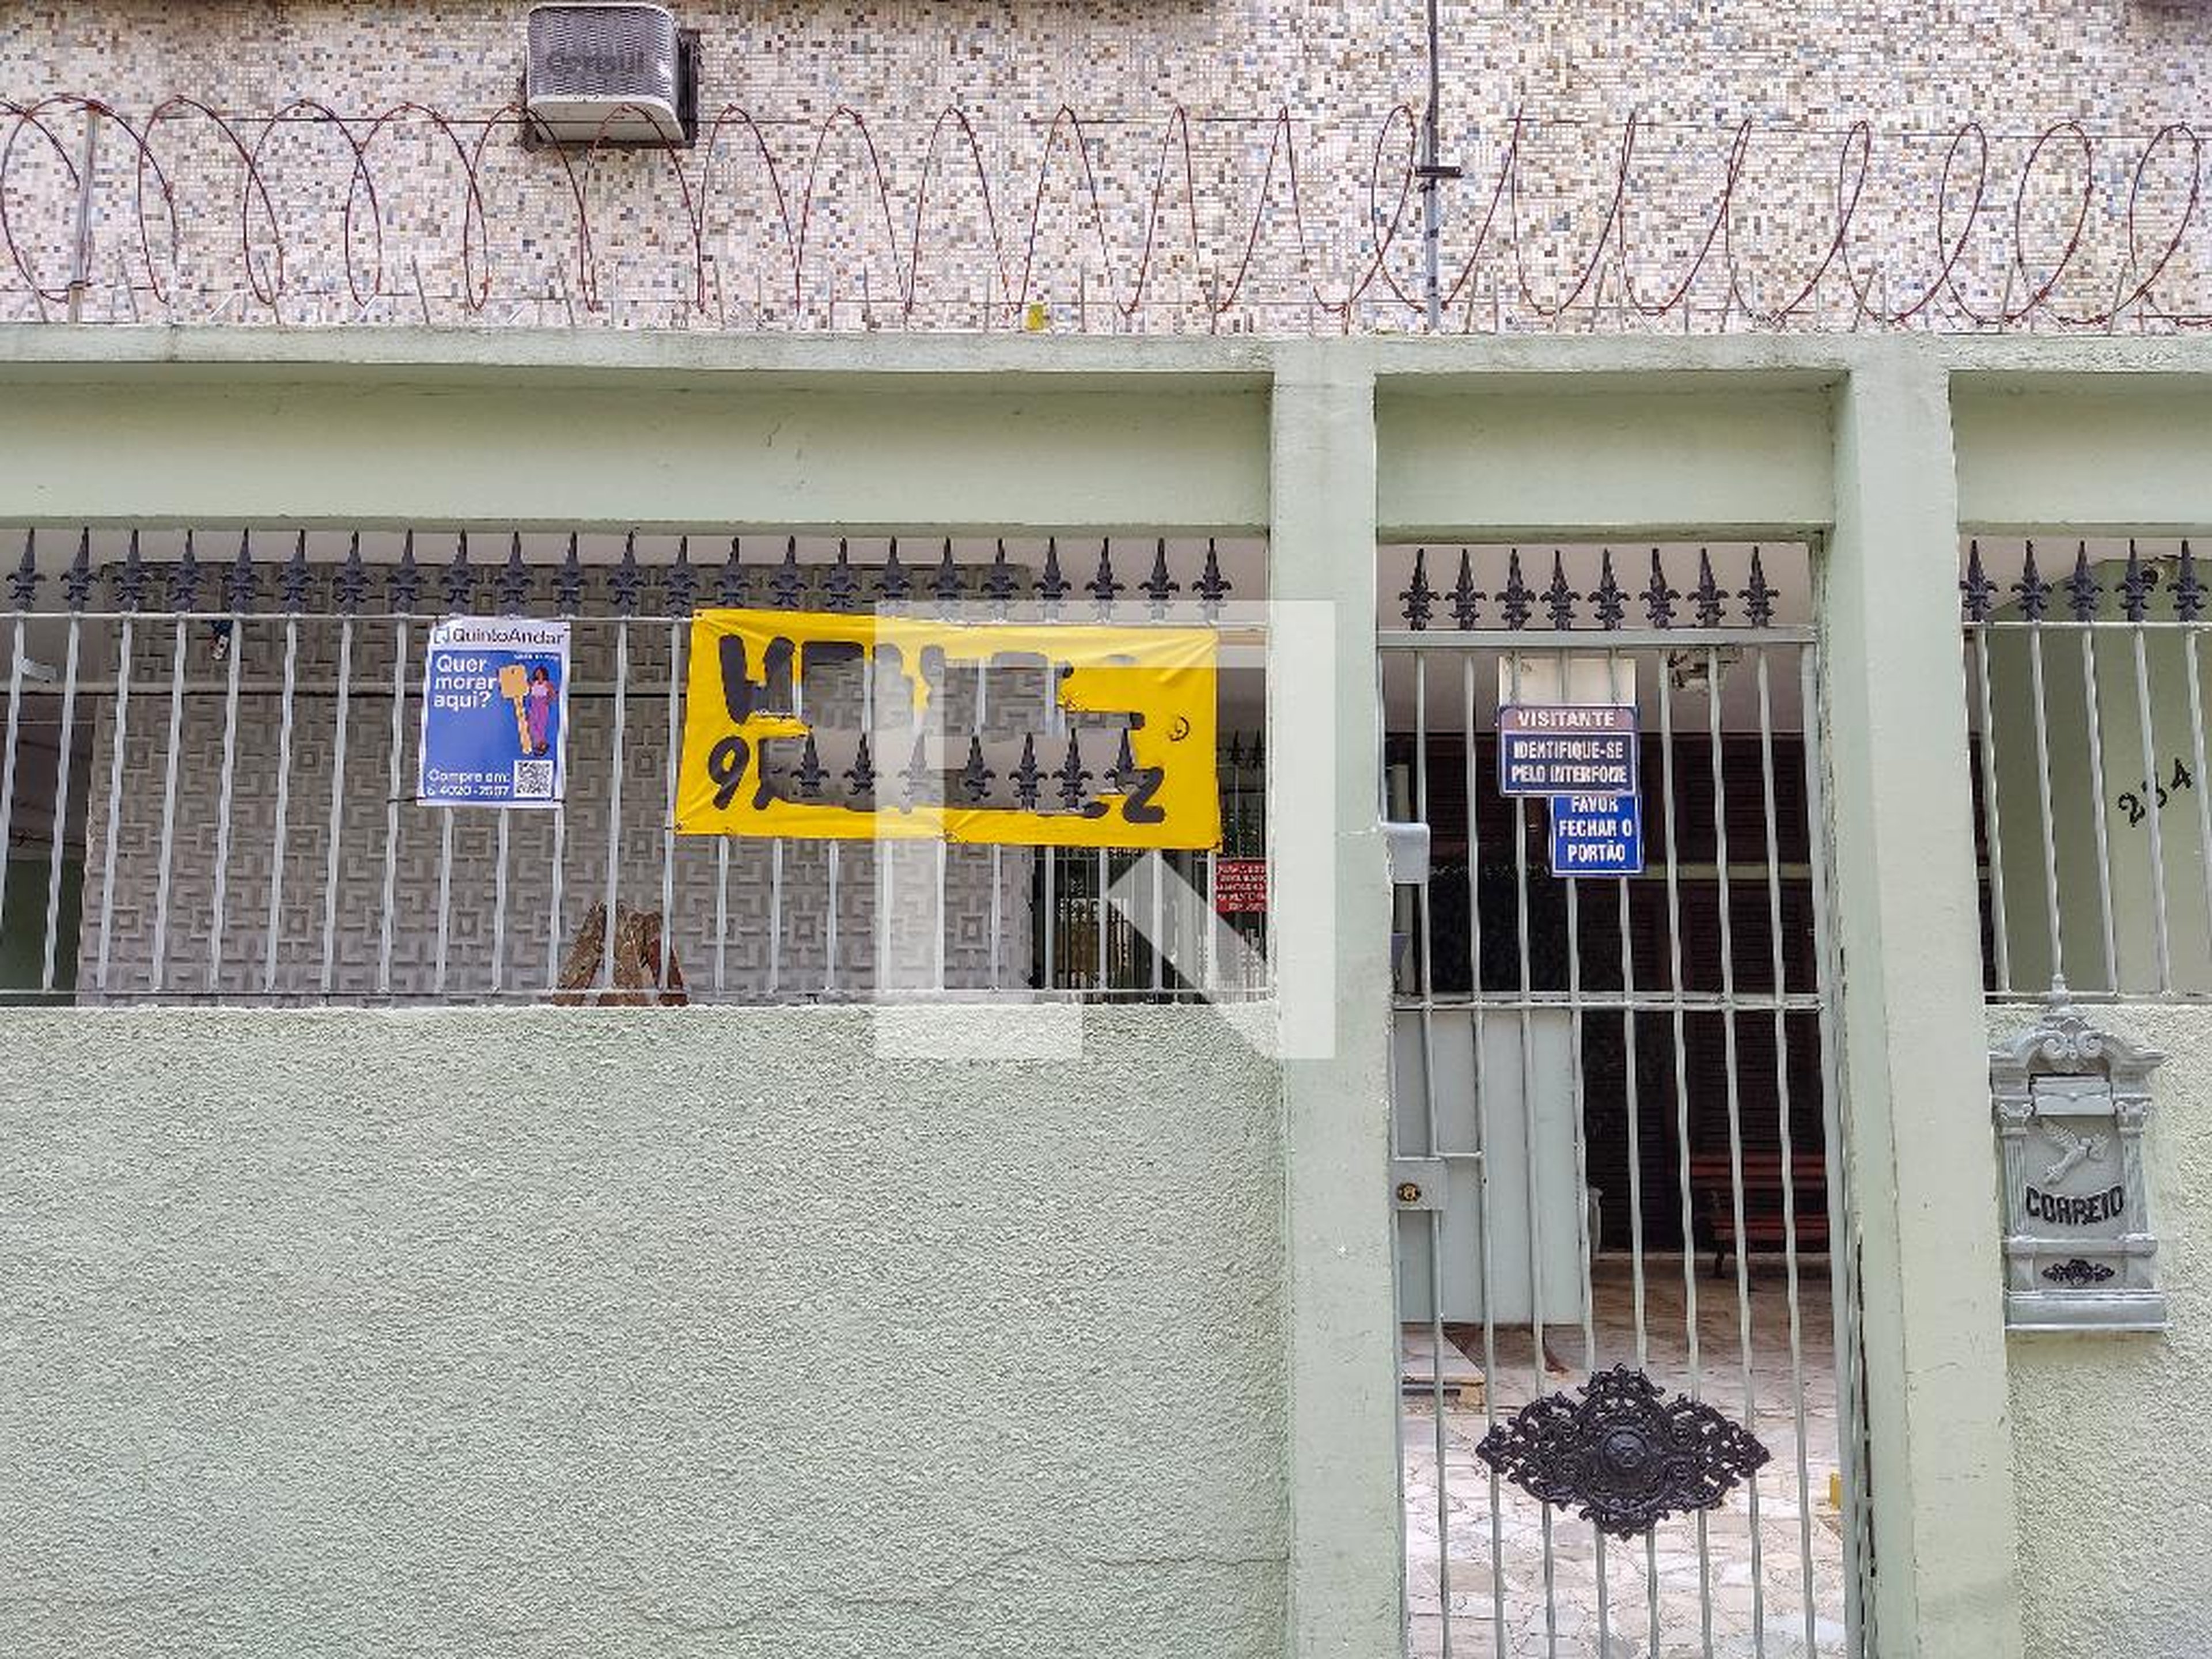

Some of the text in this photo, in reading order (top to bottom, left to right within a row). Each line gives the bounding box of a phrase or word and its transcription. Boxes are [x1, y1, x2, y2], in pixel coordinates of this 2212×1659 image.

[453, 628, 565, 645] QuintoAndar
[437, 655, 487, 673] Quer
[434, 675, 498, 691] morar
[434, 692, 491, 712] aqui?
[1518, 711, 1615, 727] VISITANTE
[1514, 741, 1623, 760] IDENTIFIQUE-SE
[1512, 765, 1627, 783] PELO INTERFONE
[1571, 797, 1619, 813] FAVOR
[1559, 819, 1633, 837] FECHAR O
[1568, 840, 1626, 862] PORTÃO
[2026, 1185, 2124, 1225] CORREIO
